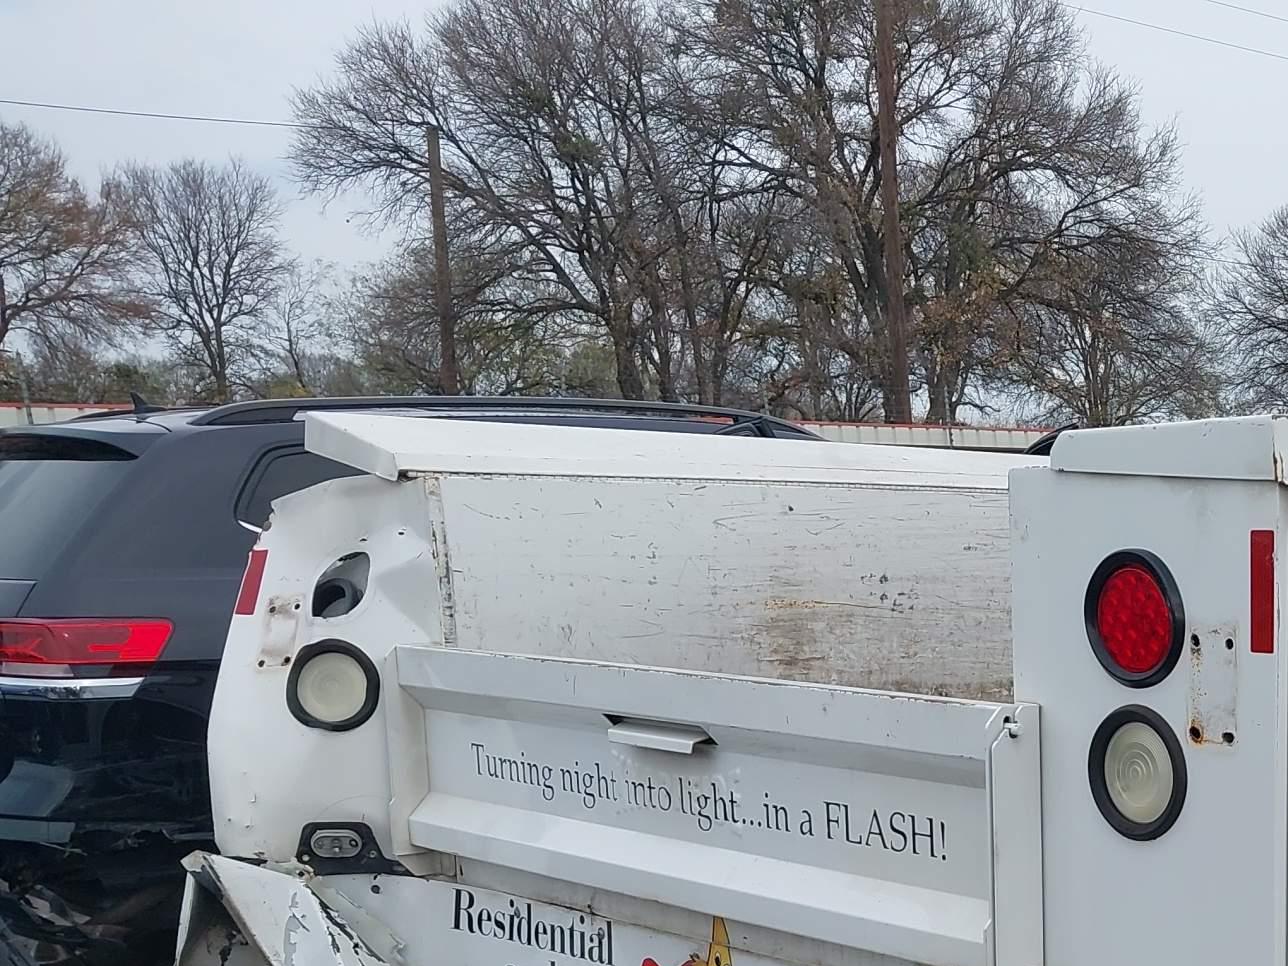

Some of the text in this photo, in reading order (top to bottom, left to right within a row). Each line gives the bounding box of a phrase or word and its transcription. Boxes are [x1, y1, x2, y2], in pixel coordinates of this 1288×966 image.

[470, 743, 554, 801] Turning
[560, 762, 618, 809] night
[624, 769, 672, 812] into
[798, 810, 815, 836] a
[823, 801, 948, 861] FLASH!
[450, 887, 616, 966] Residential
